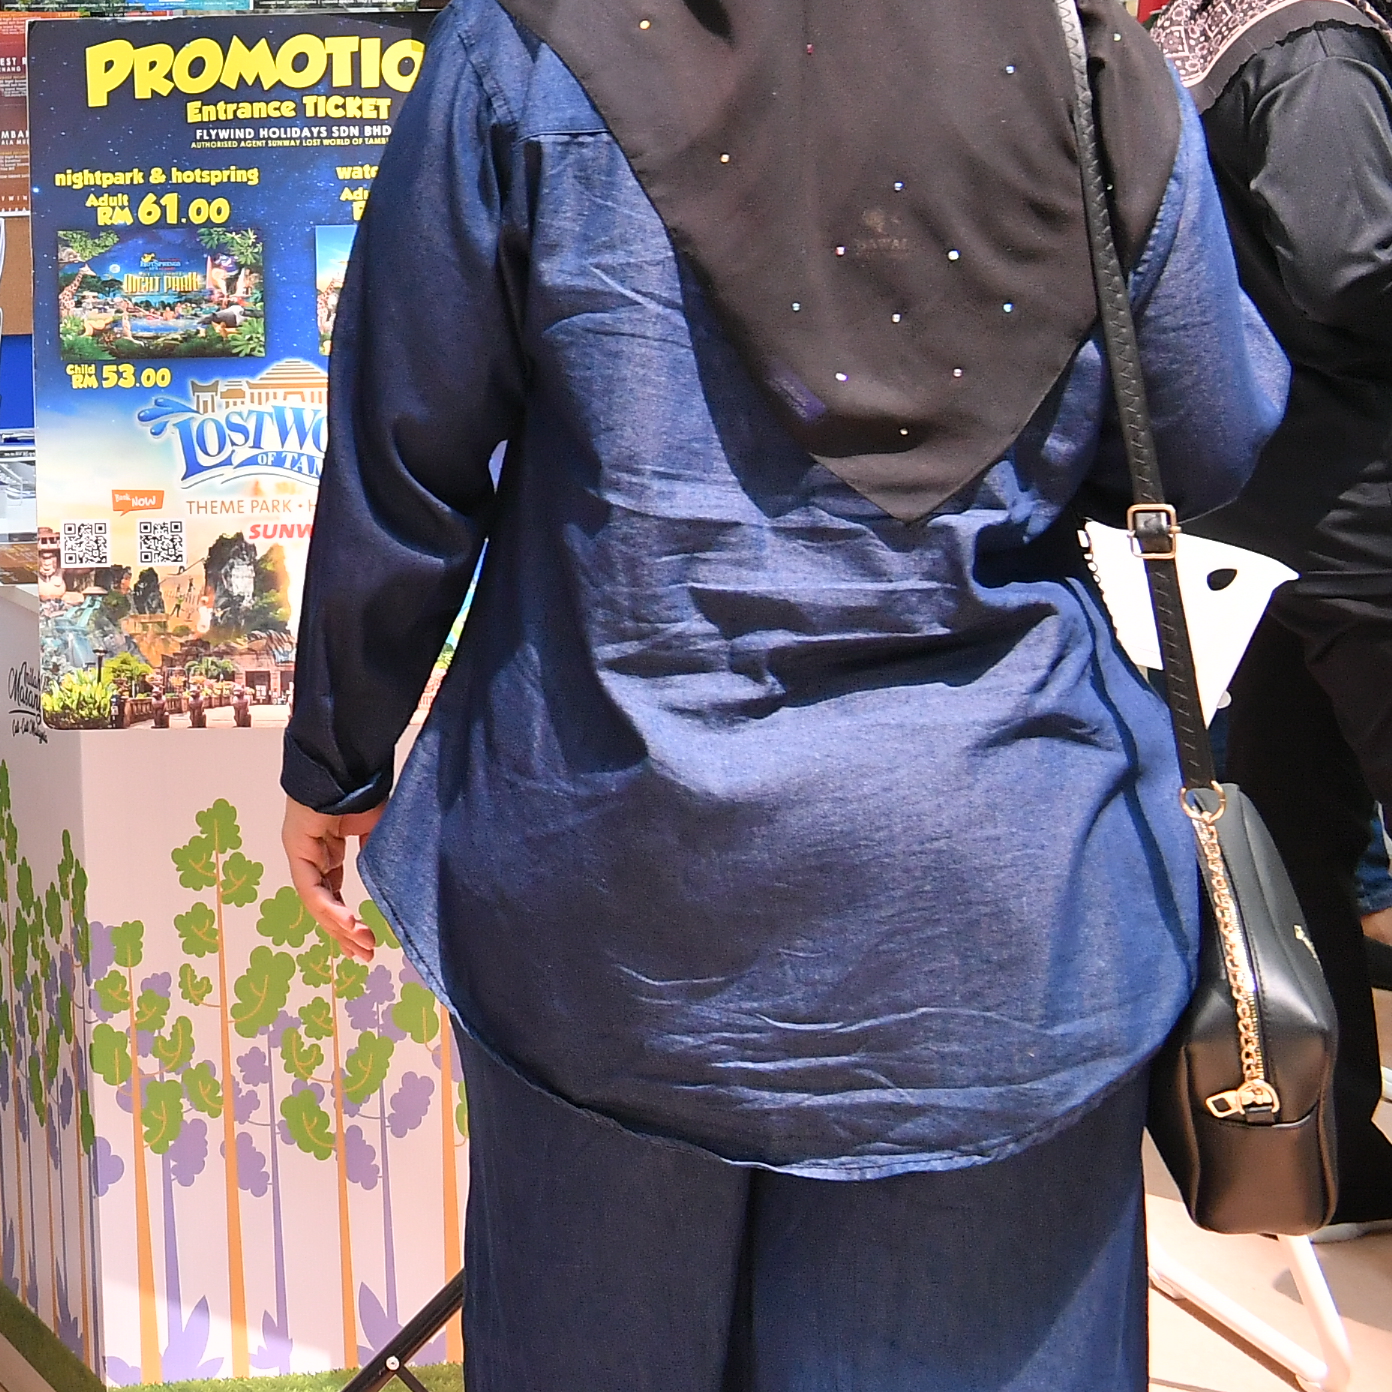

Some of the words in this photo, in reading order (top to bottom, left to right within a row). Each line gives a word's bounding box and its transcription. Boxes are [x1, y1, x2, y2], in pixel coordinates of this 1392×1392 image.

[85, 34, 425, 108] PROMOTIO
[187, 100, 296, 123] Entrance
[303, 95, 392, 120] TICKET
[196, 128, 254, 140] FLYWIND
[259, 127, 328, 138] HOLIDAYS
[332, 126, 359, 137] SDN
[365, 125, 392, 136] BHD
[240, 140, 266, 148] AGENT
[268, 139, 301, 147] SUNWAY
[322, 138, 350, 146] WORLD
[365, 137, 389, 145] TAMB
[54, 169, 144, 188] nightpark
[149, 168, 166, 185] &
[171, 166, 259, 187] hotspring
[86, 193, 129, 208] Adult
[97, 207, 133, 225] RM
[138, 193, 230, 225] 61.00
[66, 363, 95, 376] Child
[71, 374, 98, 389] RM
[101, 362, 171, 389] 53.00
[257, 451, 274, 466] OF
[132, 495, 156, 507] NOW
[186, 500, 244, 515] THEME
[250, 499, 291, 512] PARK
[249, 524, 314, 539] SUNW
